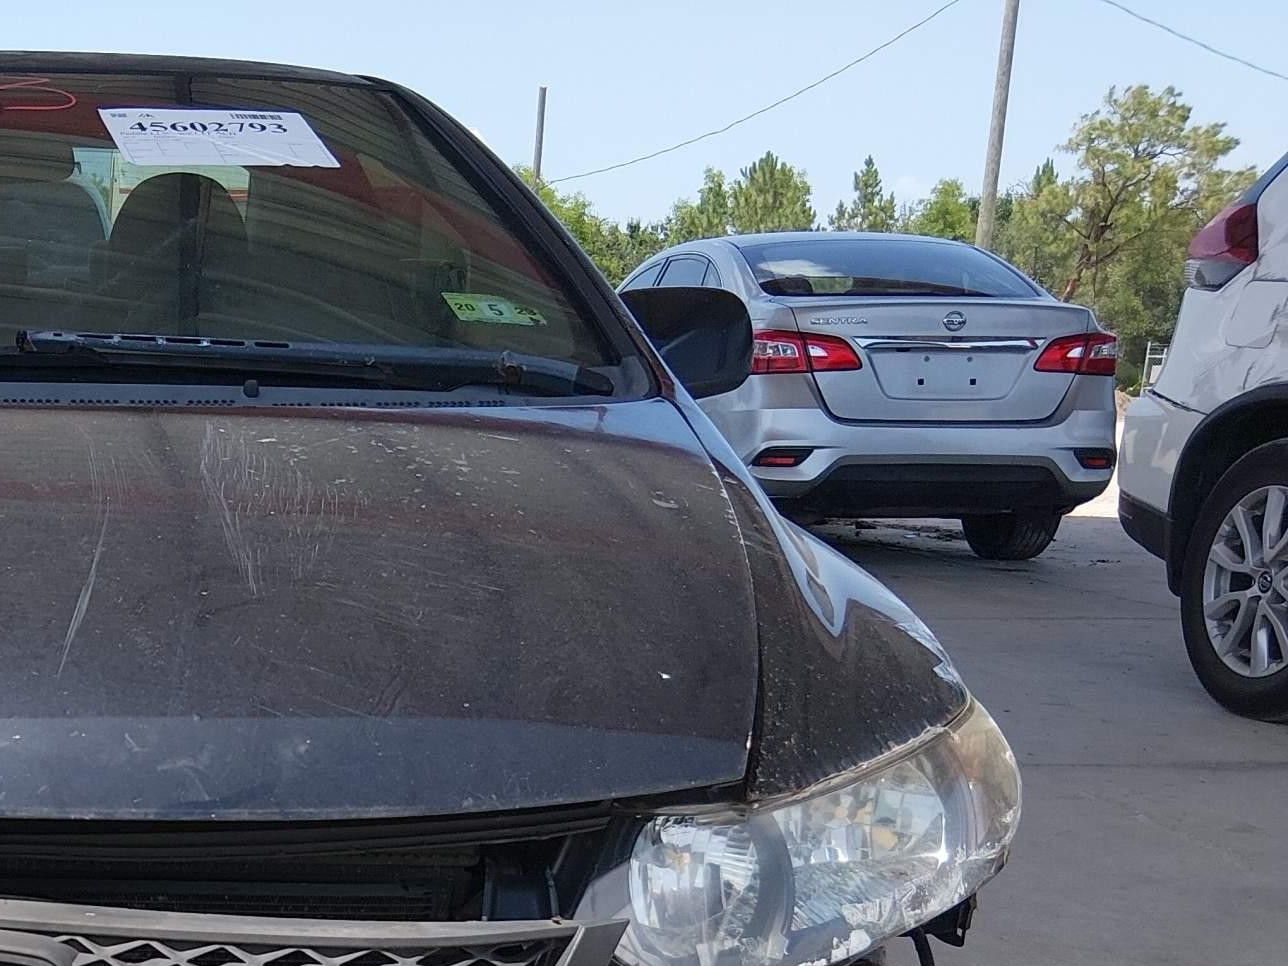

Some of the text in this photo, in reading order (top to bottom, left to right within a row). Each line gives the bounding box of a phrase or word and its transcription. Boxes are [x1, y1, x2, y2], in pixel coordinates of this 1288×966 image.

[128, 121, 288, 134] 45602793
[454, 302, 476, 312] 20
[487, 303, 504, 317] 5
[809, 316, 868, 326] SENTRA
